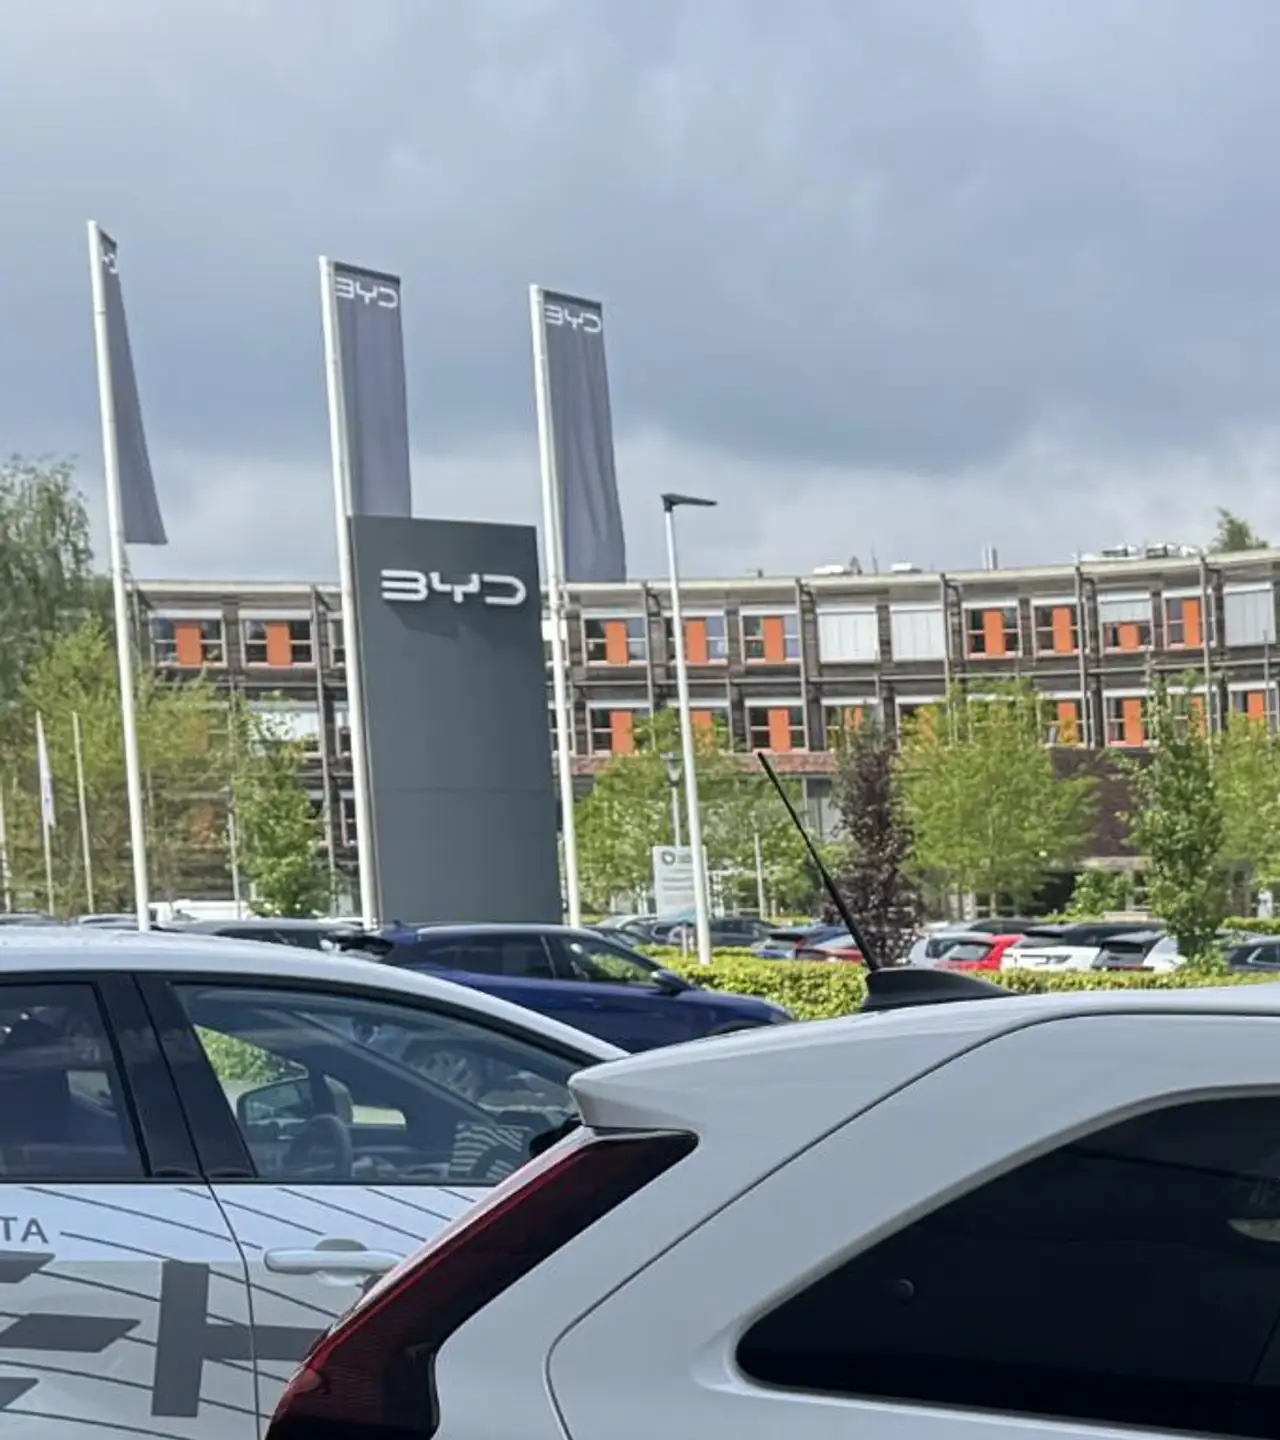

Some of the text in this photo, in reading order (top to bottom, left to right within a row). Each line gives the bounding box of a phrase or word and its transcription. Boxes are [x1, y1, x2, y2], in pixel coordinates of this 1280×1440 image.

[335, 276, 399, 309] BYD
[544, 304, 602, 333] BYD
[380, 568, 527, 606] BYD
